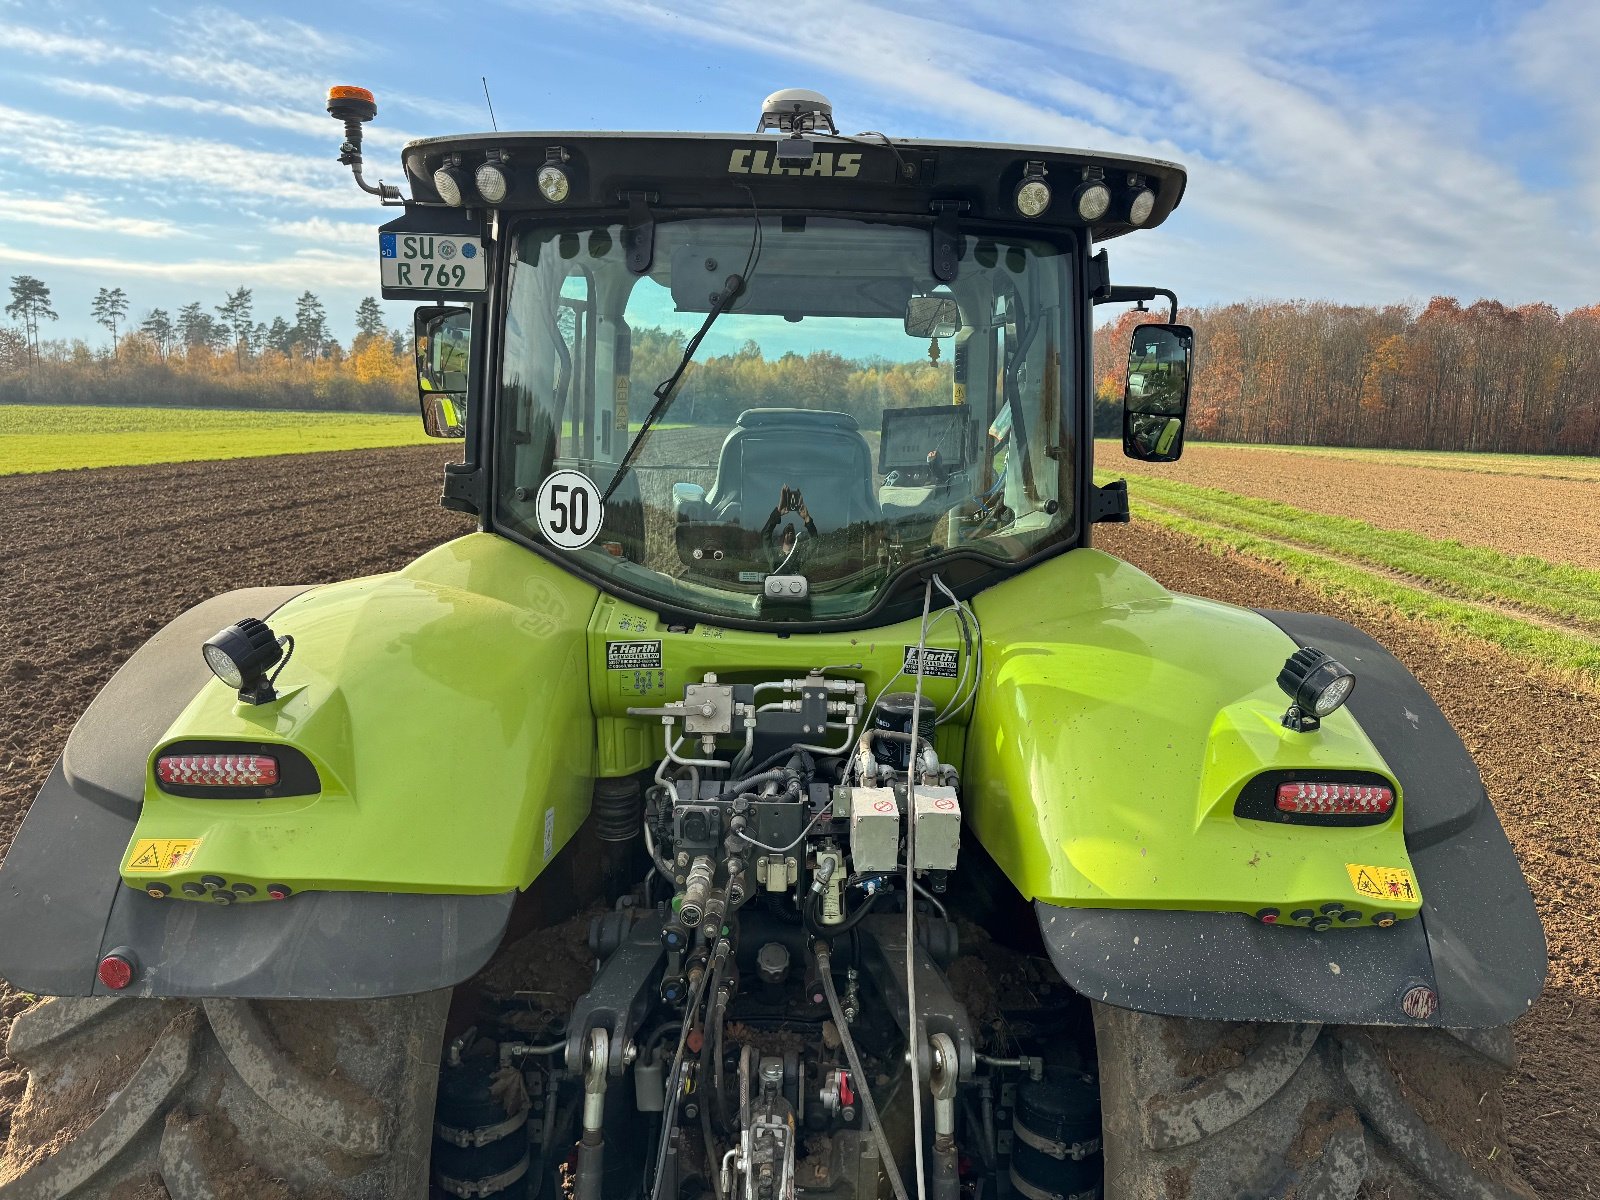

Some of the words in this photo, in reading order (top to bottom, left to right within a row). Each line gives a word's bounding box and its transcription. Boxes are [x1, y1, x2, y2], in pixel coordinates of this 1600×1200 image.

[403, 236, 434, 260] SU
[397, 262, 412, 286] R
[420, 263, 466, 287] 769
[549, 484, 589, 536] 50
